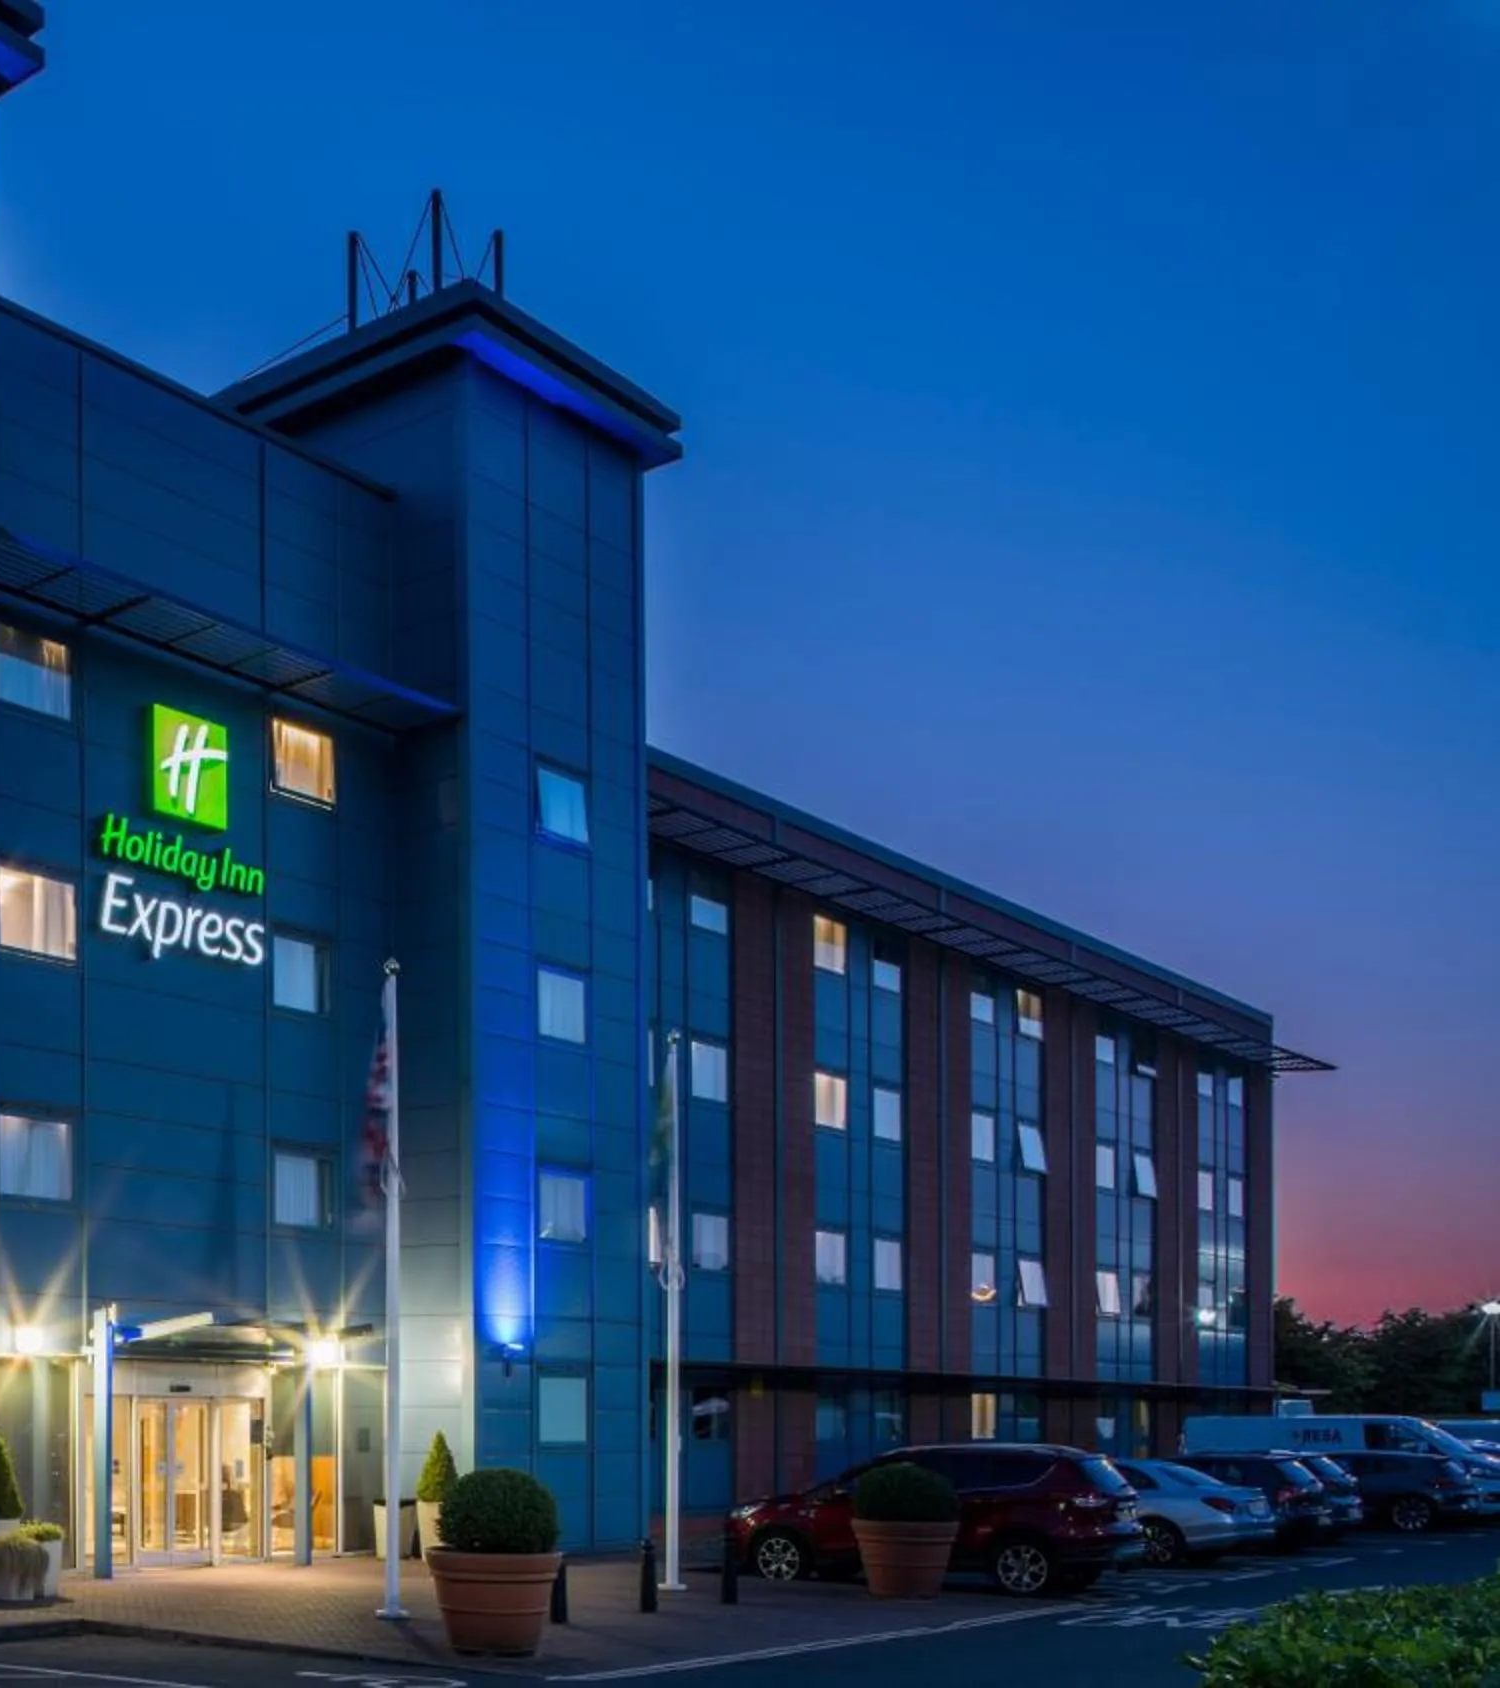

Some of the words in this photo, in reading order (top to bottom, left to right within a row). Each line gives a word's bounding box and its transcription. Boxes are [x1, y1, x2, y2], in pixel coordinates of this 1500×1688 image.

[101, 813, 216, 891] Holiday
[221, 848, 264, 896] Inn
[100, 872, 265, 966] Express
